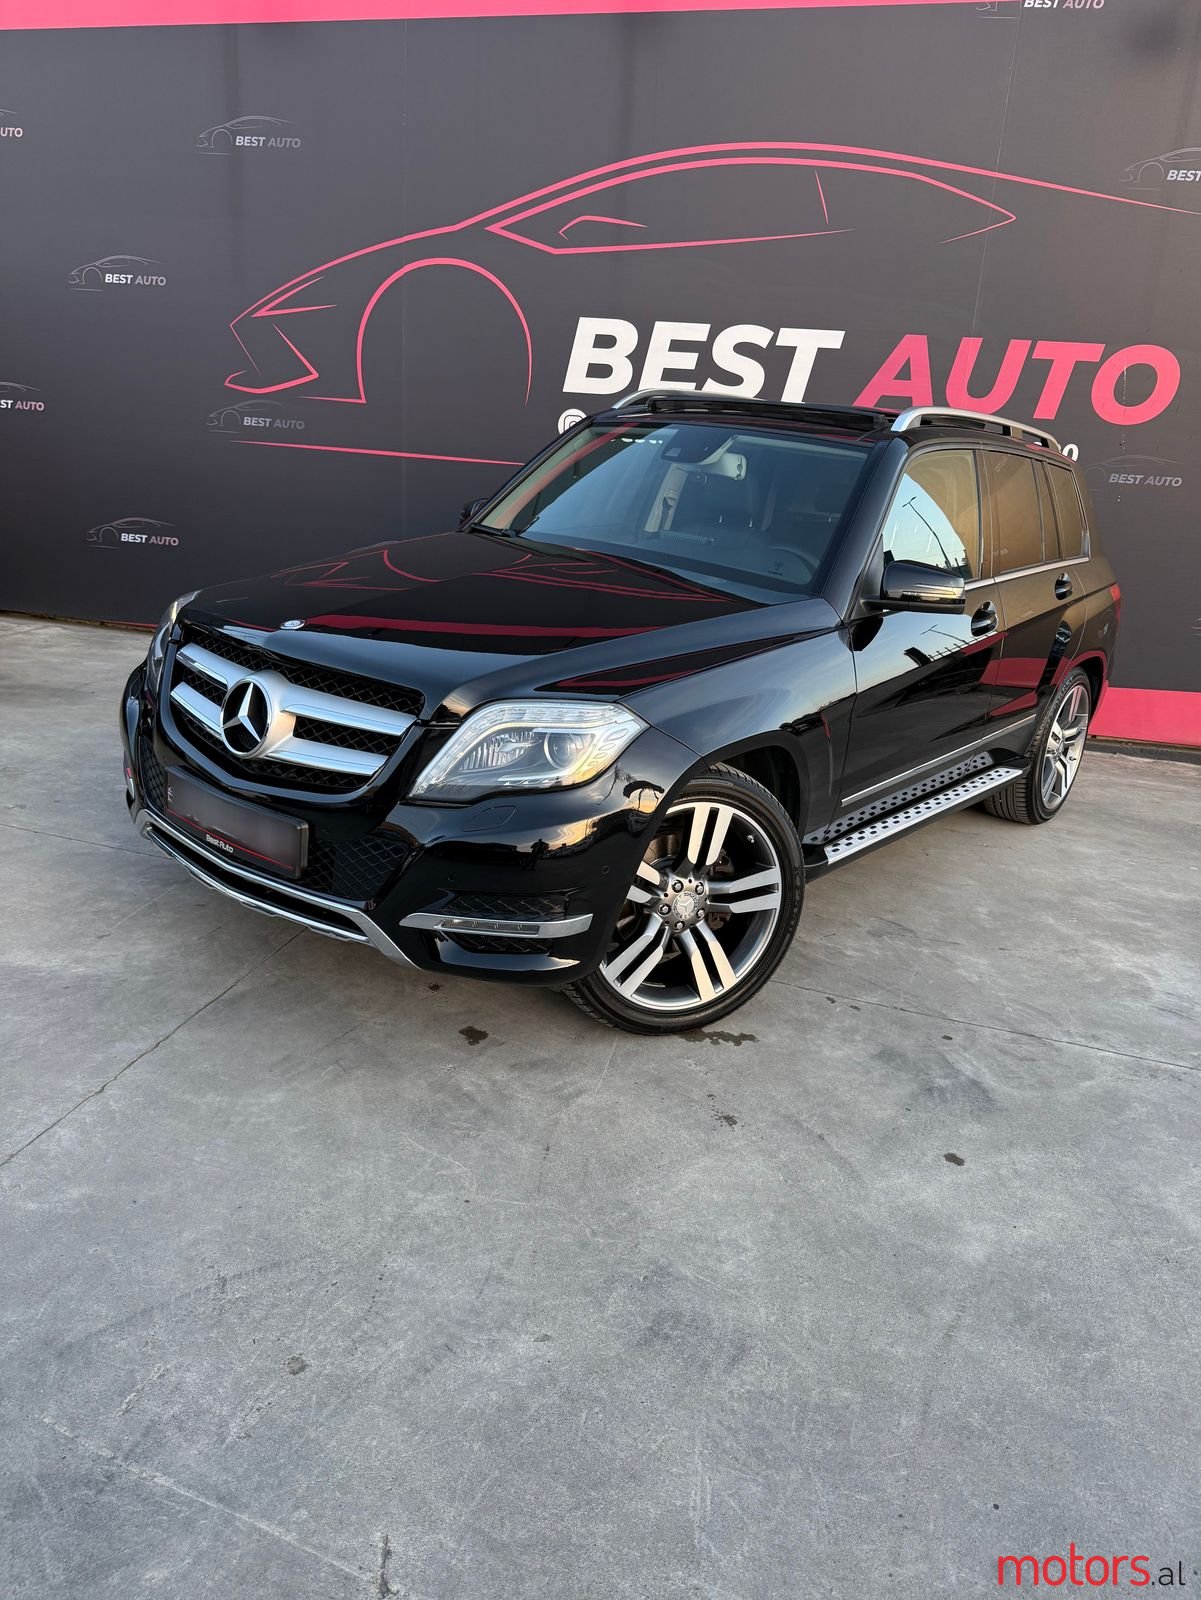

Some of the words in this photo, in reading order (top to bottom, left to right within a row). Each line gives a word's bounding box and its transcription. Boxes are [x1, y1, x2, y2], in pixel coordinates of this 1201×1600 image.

[1024, 0, 1059, 8] BEST
[1062, 0, 1105, 9] AUTO
[0, 127, 23, 138] UTO
[235, 135, 266, 147] BEST
[267, 137, 301, 149] AUTO
[1166, 169, 1201, 182] BEST
[104, 273, 134, 284] BEST
[134, 275, 167, 286] AUTO
[562, 316, 846, 404] BEST
[850, 333, 1181, 426] AUTO
[0, 399, 14, 409] ST
[15, 400, 45, 411] AUTO
[243, 416, 272, 427] BEST
[273, 419, 305, 430] AUTO
[1108, 473, 1144, 484] BEST
[1144, 475, 1183, 487] AUTO
[120, 533, 148, 544] BEST
[148, 535, 179, 546] AUTO
